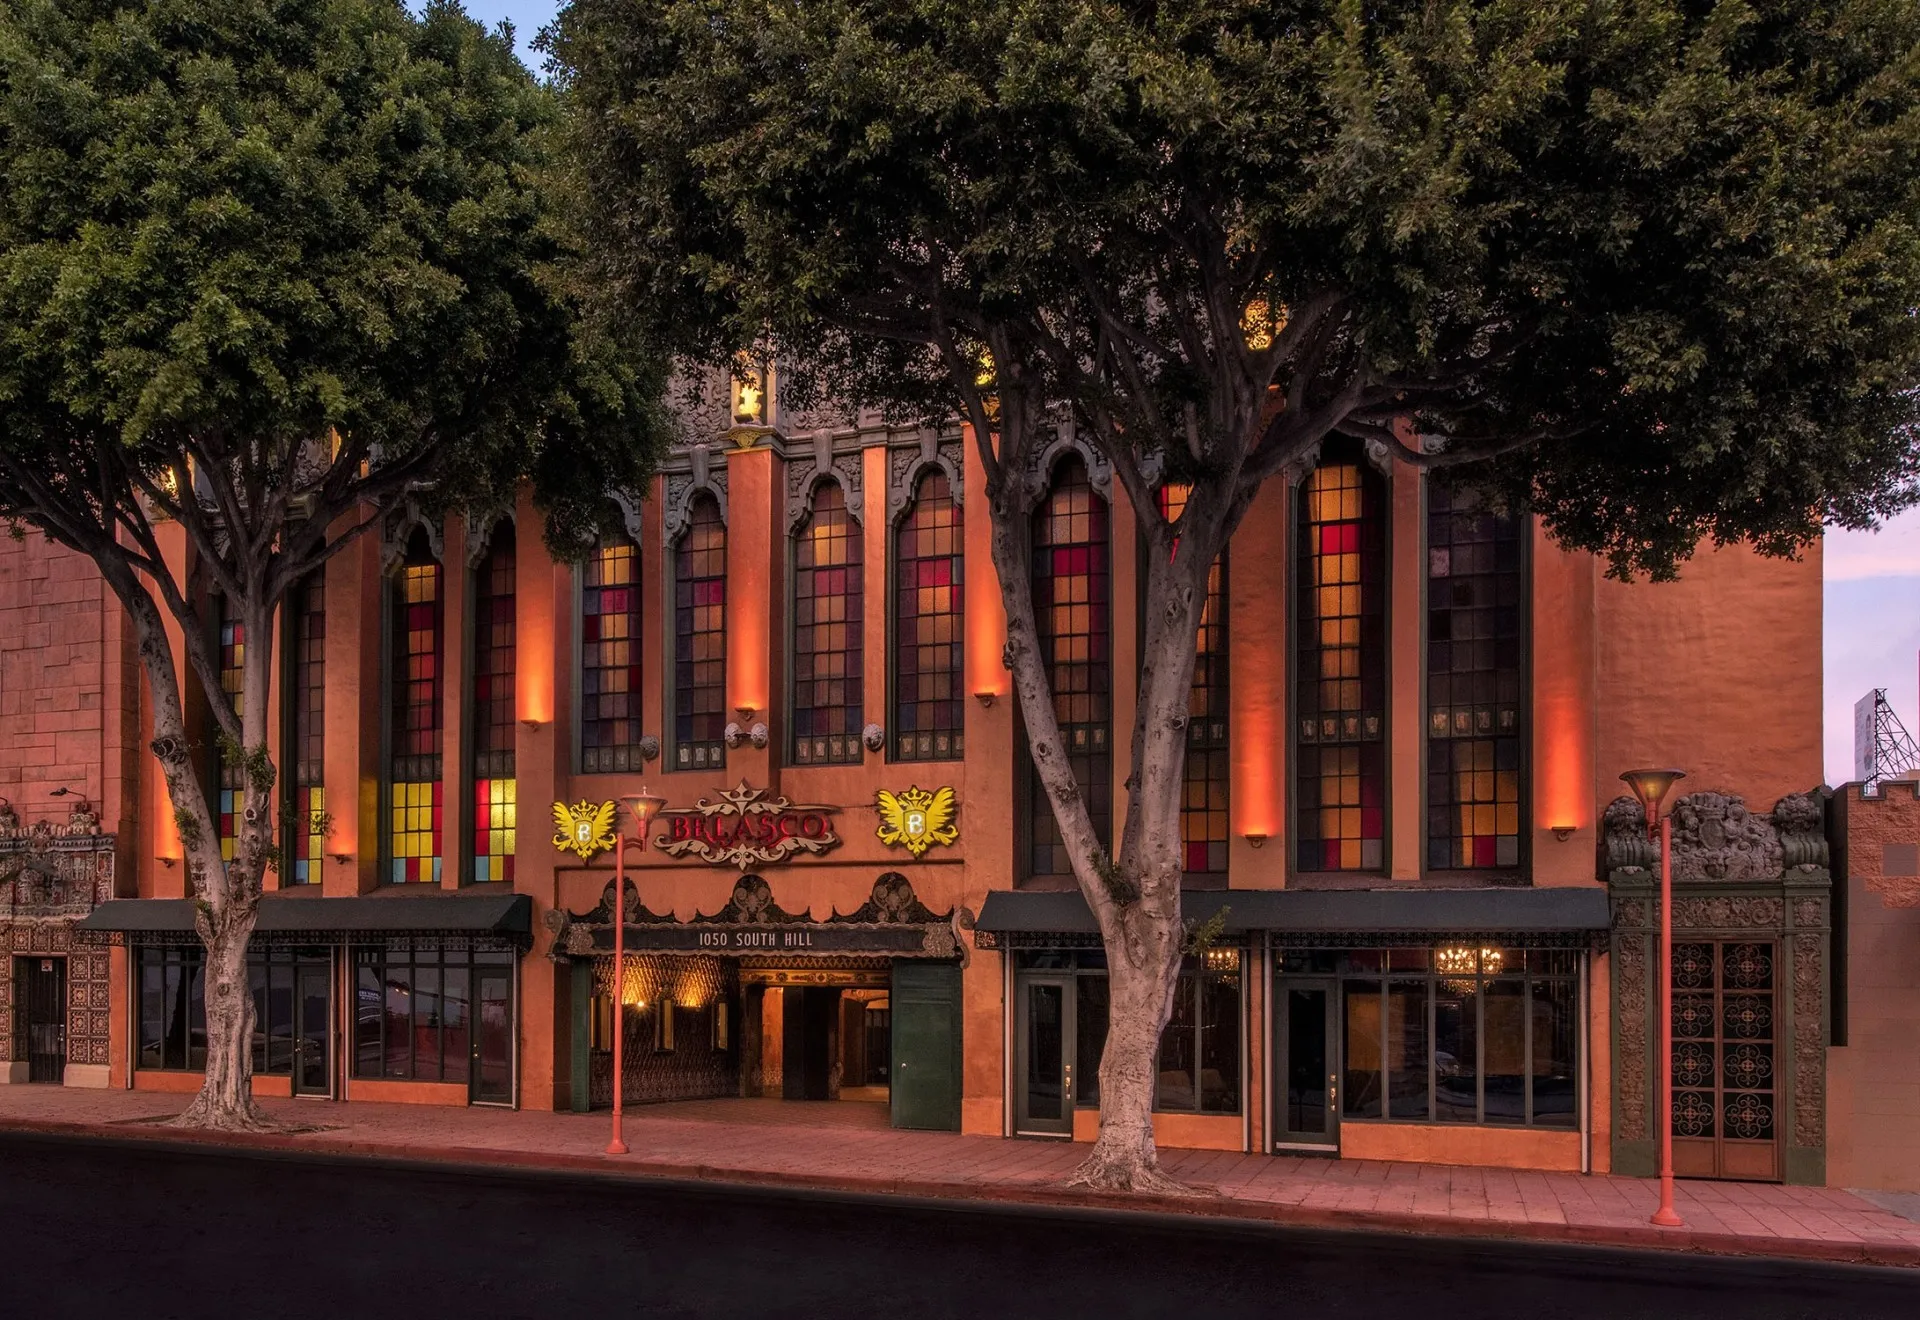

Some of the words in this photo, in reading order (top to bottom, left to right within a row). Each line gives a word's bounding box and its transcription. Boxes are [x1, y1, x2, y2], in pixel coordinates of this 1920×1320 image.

[671, 814, 829, 847] BELASCO
[908, 814, 923, 834] B
[699, 932, 728, 946] 1050
[736, 932, 776, 946] SOUTH
[784, 932, 813, 946] HILL
